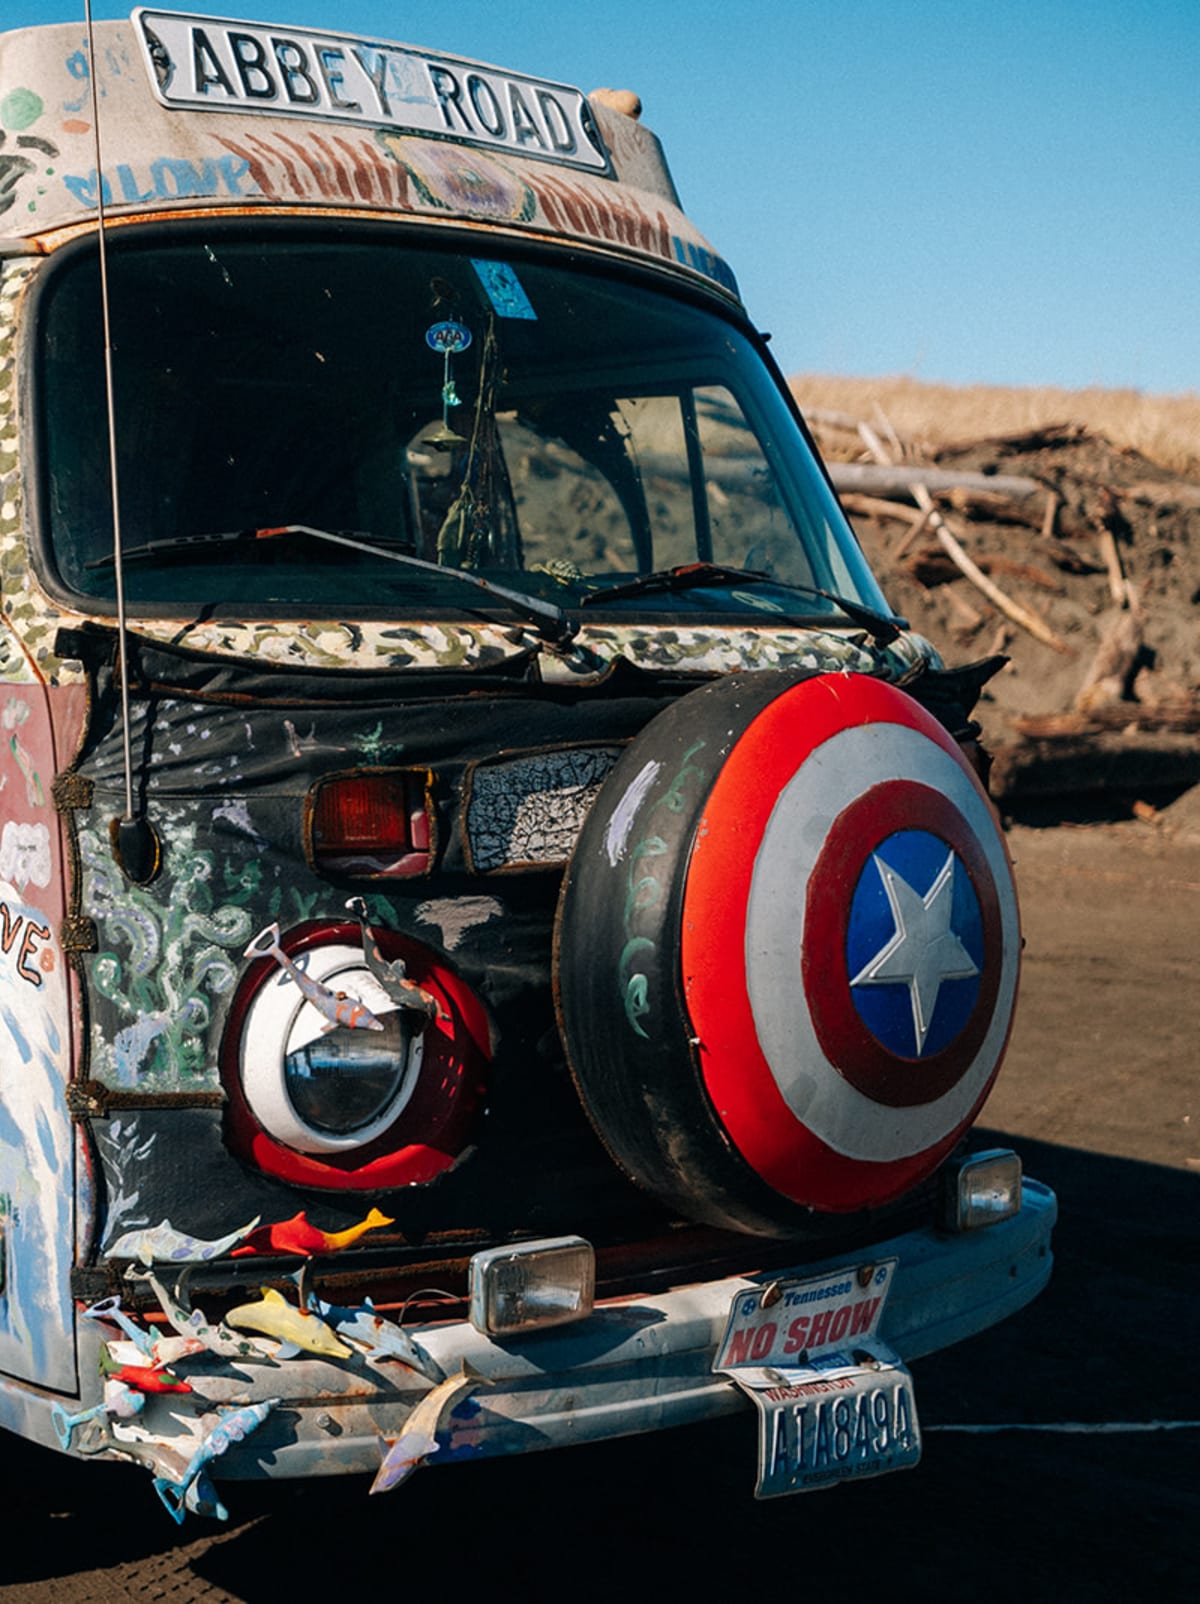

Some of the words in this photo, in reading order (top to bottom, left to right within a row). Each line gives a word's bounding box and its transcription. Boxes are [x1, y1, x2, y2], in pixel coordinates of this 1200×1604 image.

[188, 25, 392, 117] ABBEY
[424, 62, 578, 156] ROAD
[784, 1281, 853, 1307] Tennessee
[724, 1322, 777, 1366] NO
[783, 1296, 882, 1354] SHOW
